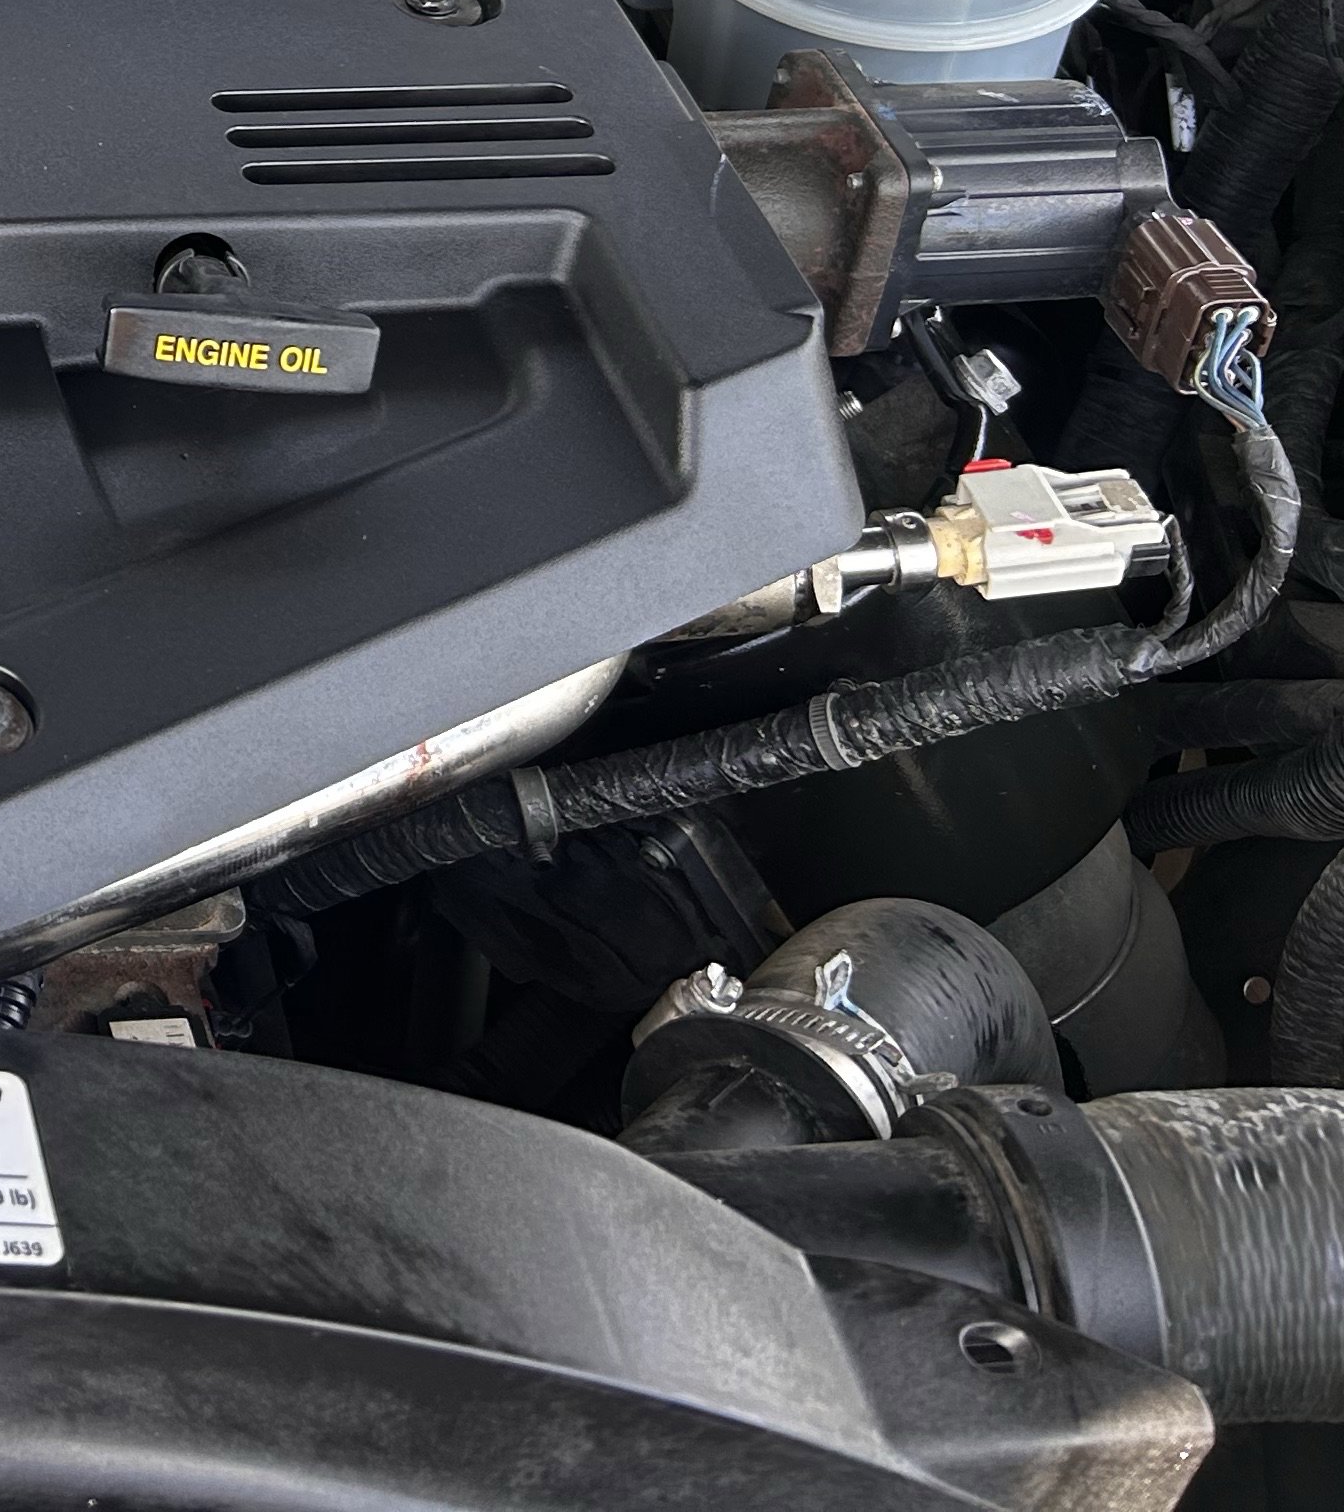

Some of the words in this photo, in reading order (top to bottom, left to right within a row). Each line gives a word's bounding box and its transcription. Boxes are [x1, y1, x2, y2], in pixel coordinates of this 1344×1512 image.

[154, 334, 270, 370] ENGINE
[279, 346, 328, 374] OIL
[9, 1188, 37, 1211] lb)
[2, 1239, 44, 1257] J639
